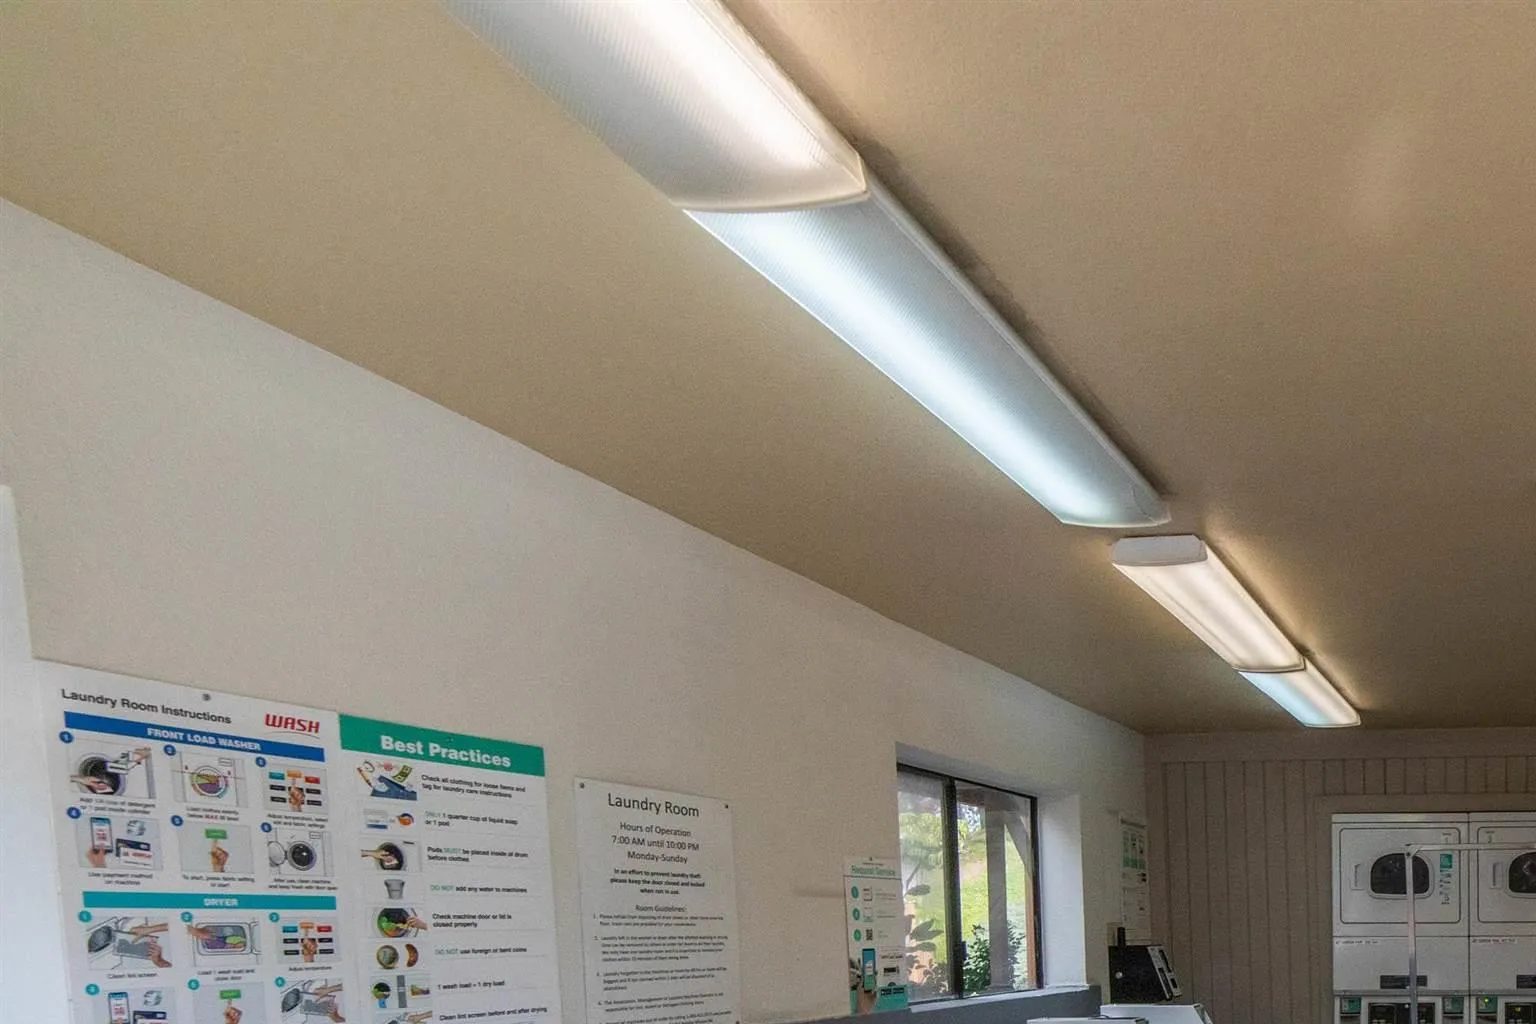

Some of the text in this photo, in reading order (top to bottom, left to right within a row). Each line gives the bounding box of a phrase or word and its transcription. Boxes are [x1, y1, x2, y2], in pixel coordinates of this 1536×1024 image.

[61, 688, 232, 725] Laundry Room Instructions
[264, 713, 320, 734] WASH
[146, 728, 262, 751] FRONT LOAD WASHER
[380, 735, 512, 768] Best Practices
[421, 774, 440, 782] Check
[608, 793, 700, 817] Laundry Room
[620, 822, 692, 838] Hours of Operation
[612, 835, 700, 851] 7:00 AM until 10:00 PM
[627, 851, 688, 864] Monday-Sunday
[203, 898, 239, 907] DRYER
